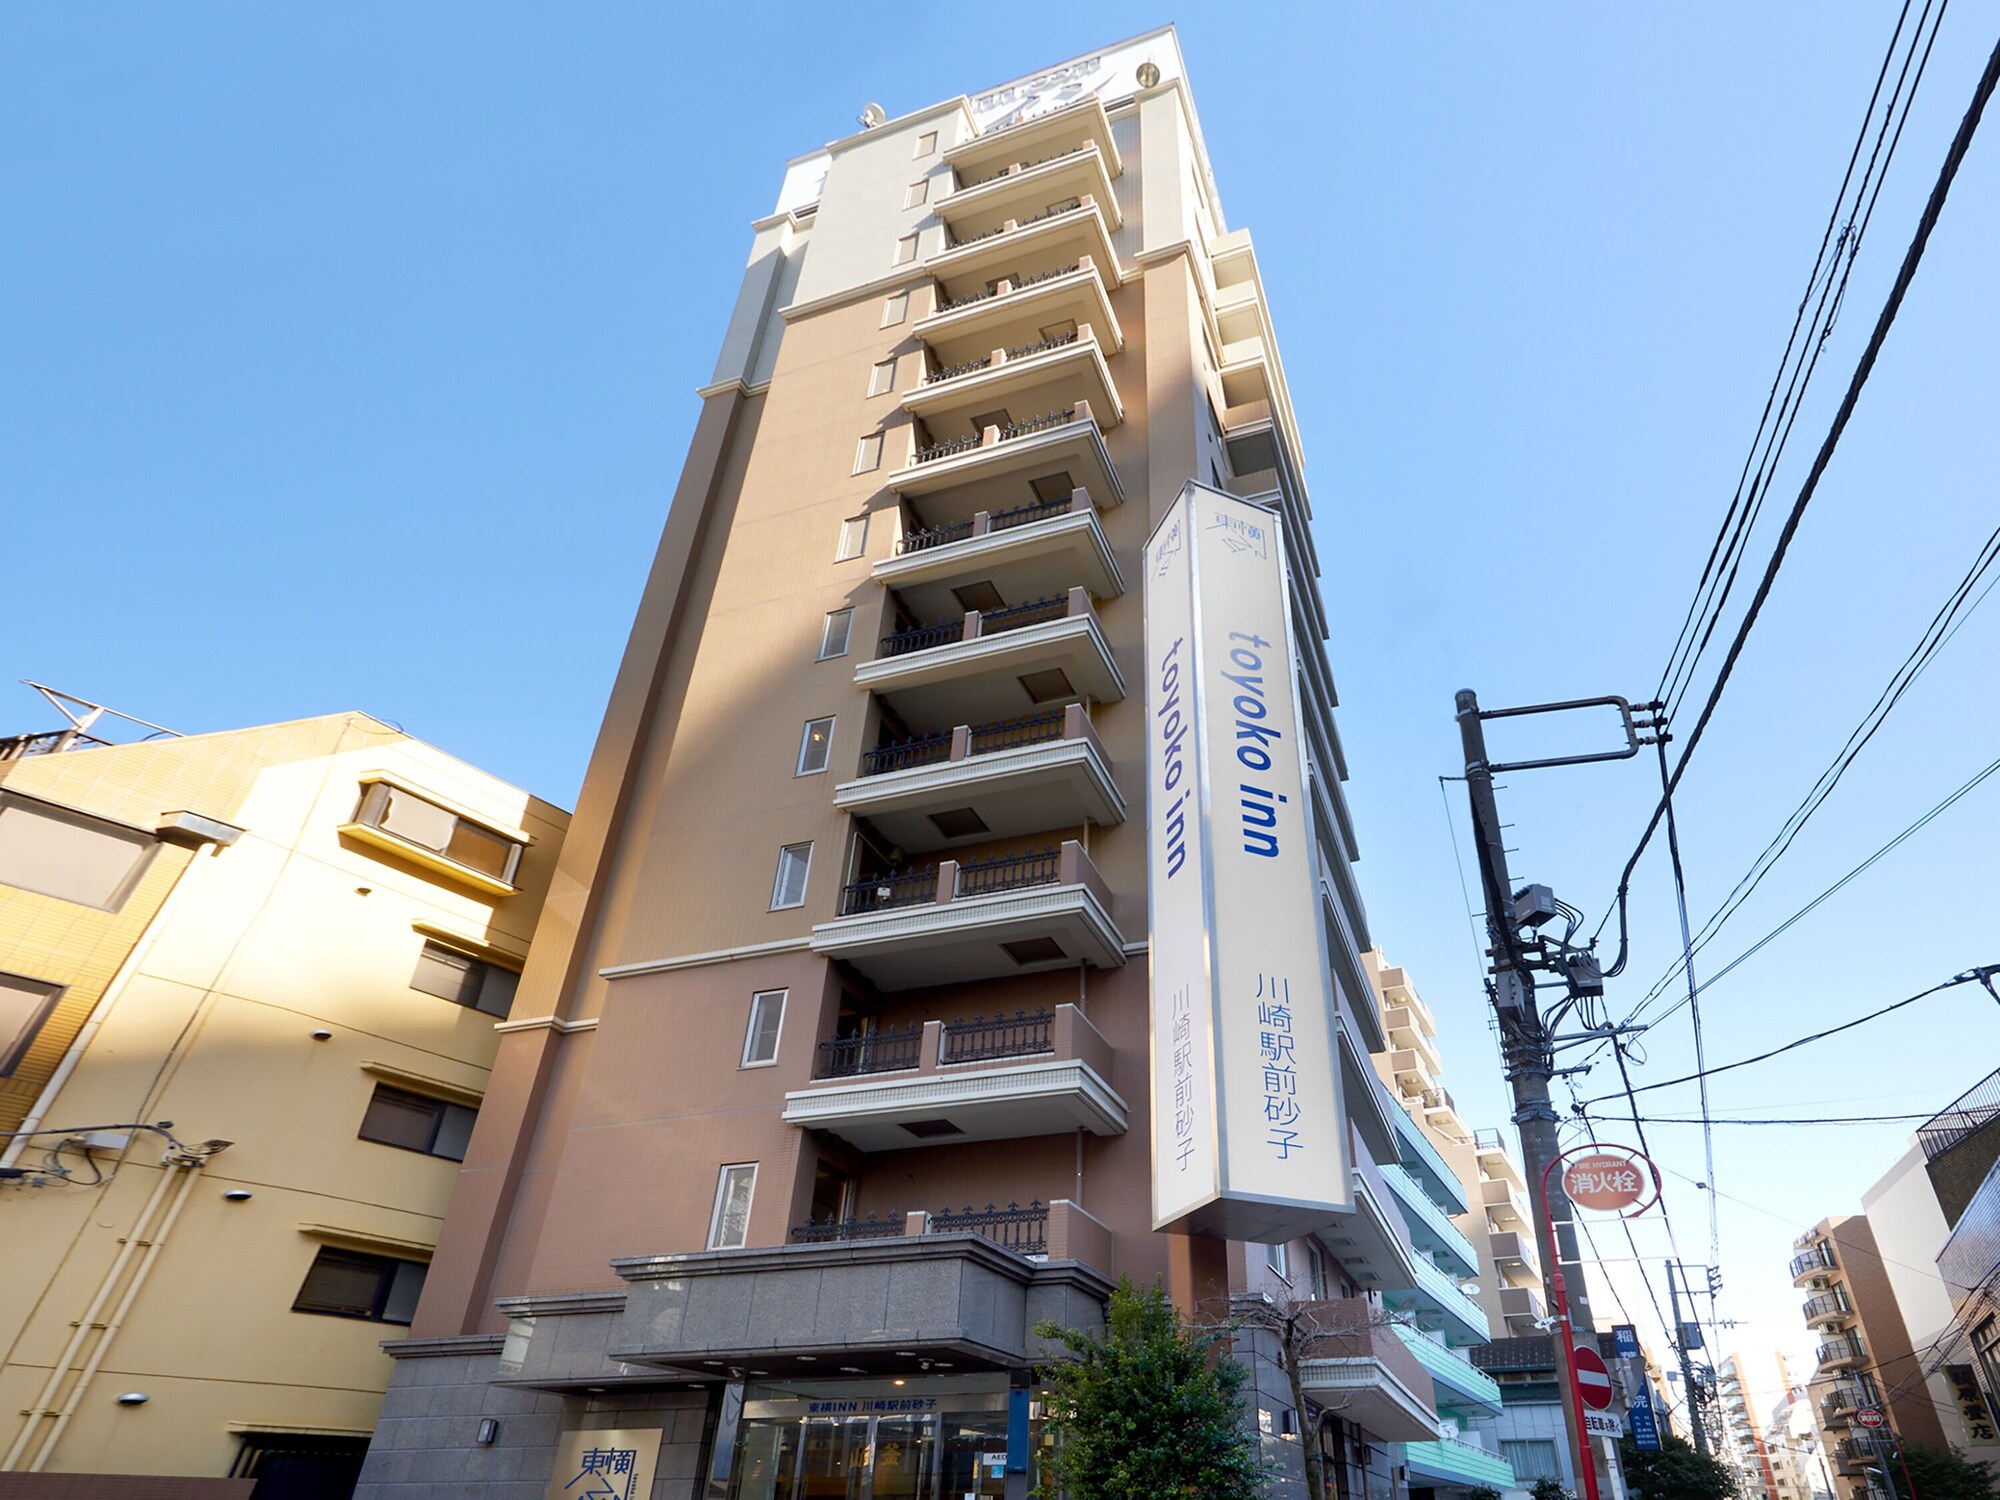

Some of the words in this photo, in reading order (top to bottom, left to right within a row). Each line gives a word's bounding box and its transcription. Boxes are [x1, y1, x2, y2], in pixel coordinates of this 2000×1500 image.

[1158, 637, 1188, 791] toyoko
[1220, 631, 1282, 771] toyoko
[1166, 788, 1191, 879] inn
[1240, 784, 1288, 858] inn
[1172, 982, 1196, 1172] 川崎駅前砂子
[1255, 973, 1304, 1160] 川崎駅前砂子
[1569, 1170, 1638, 1195] 消火栓
[1574, 1162, 1592, 1170] FIRE
[1592, 1161, 1627, 1169] HYDRANT
[808, 1402, 857, 1413] 東横INN
[862, 1399, 937, 1412] 川崎駅前砂子
